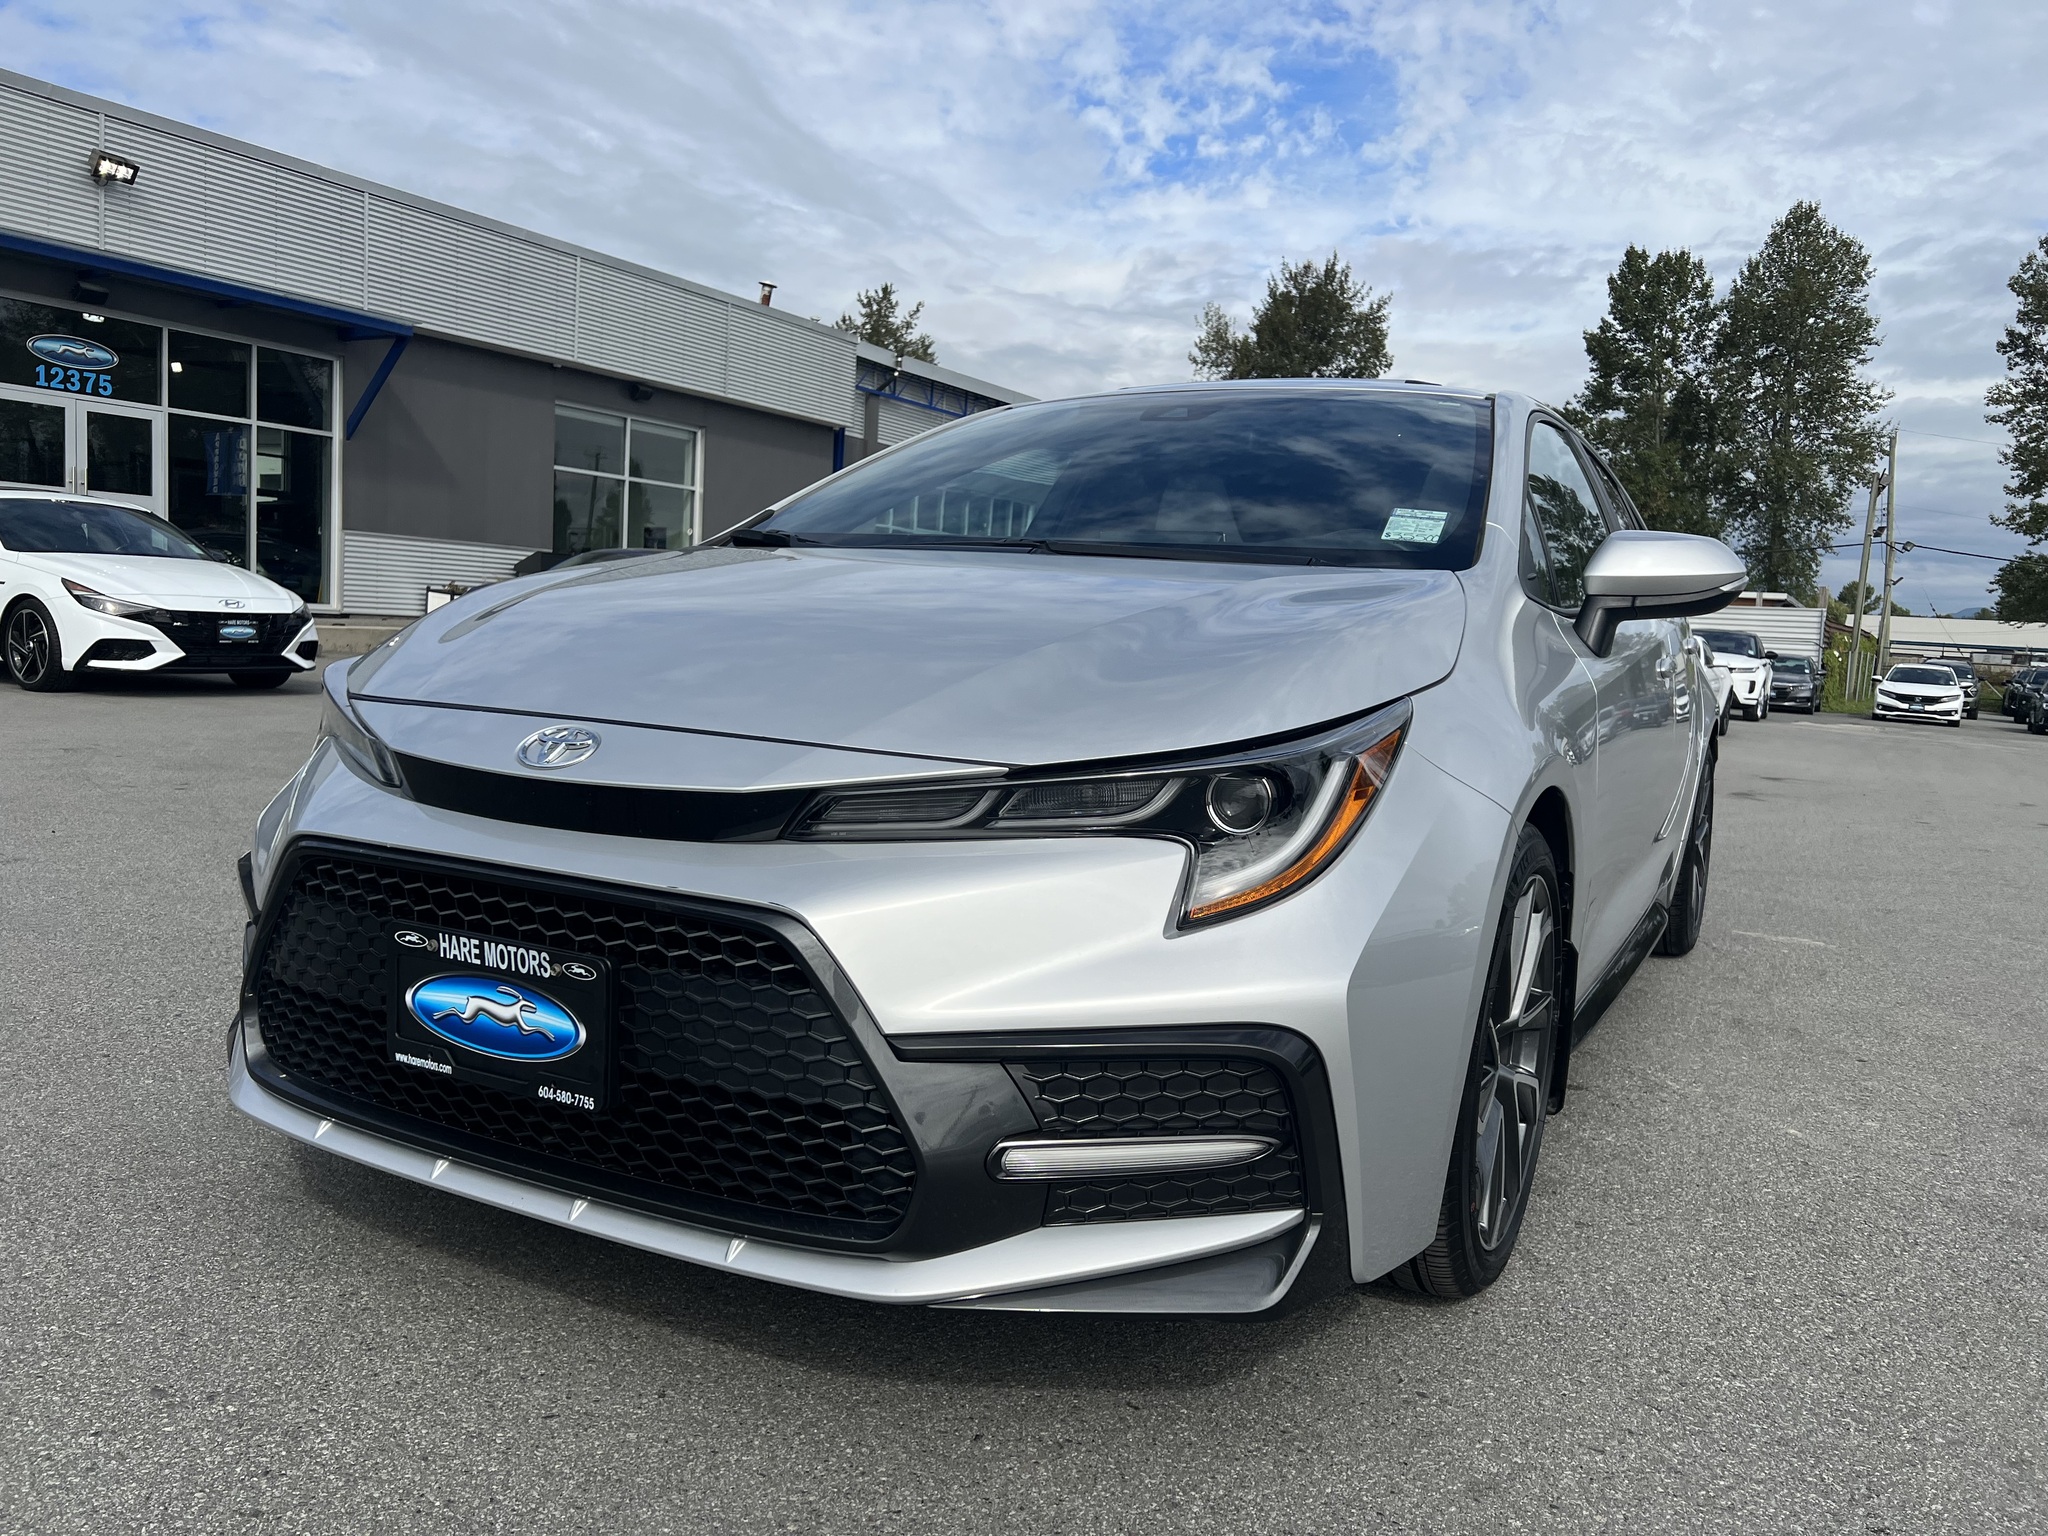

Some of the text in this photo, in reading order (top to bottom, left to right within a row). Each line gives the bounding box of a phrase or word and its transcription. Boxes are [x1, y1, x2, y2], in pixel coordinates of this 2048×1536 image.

[36, 365, 113, 396] 12375
[438, 932, 551, 978] HARE MOTORS
[394, 1051, 452, 1075] www.haremotors.com
[537, 1085, 595, 1111] 604-580-7755
